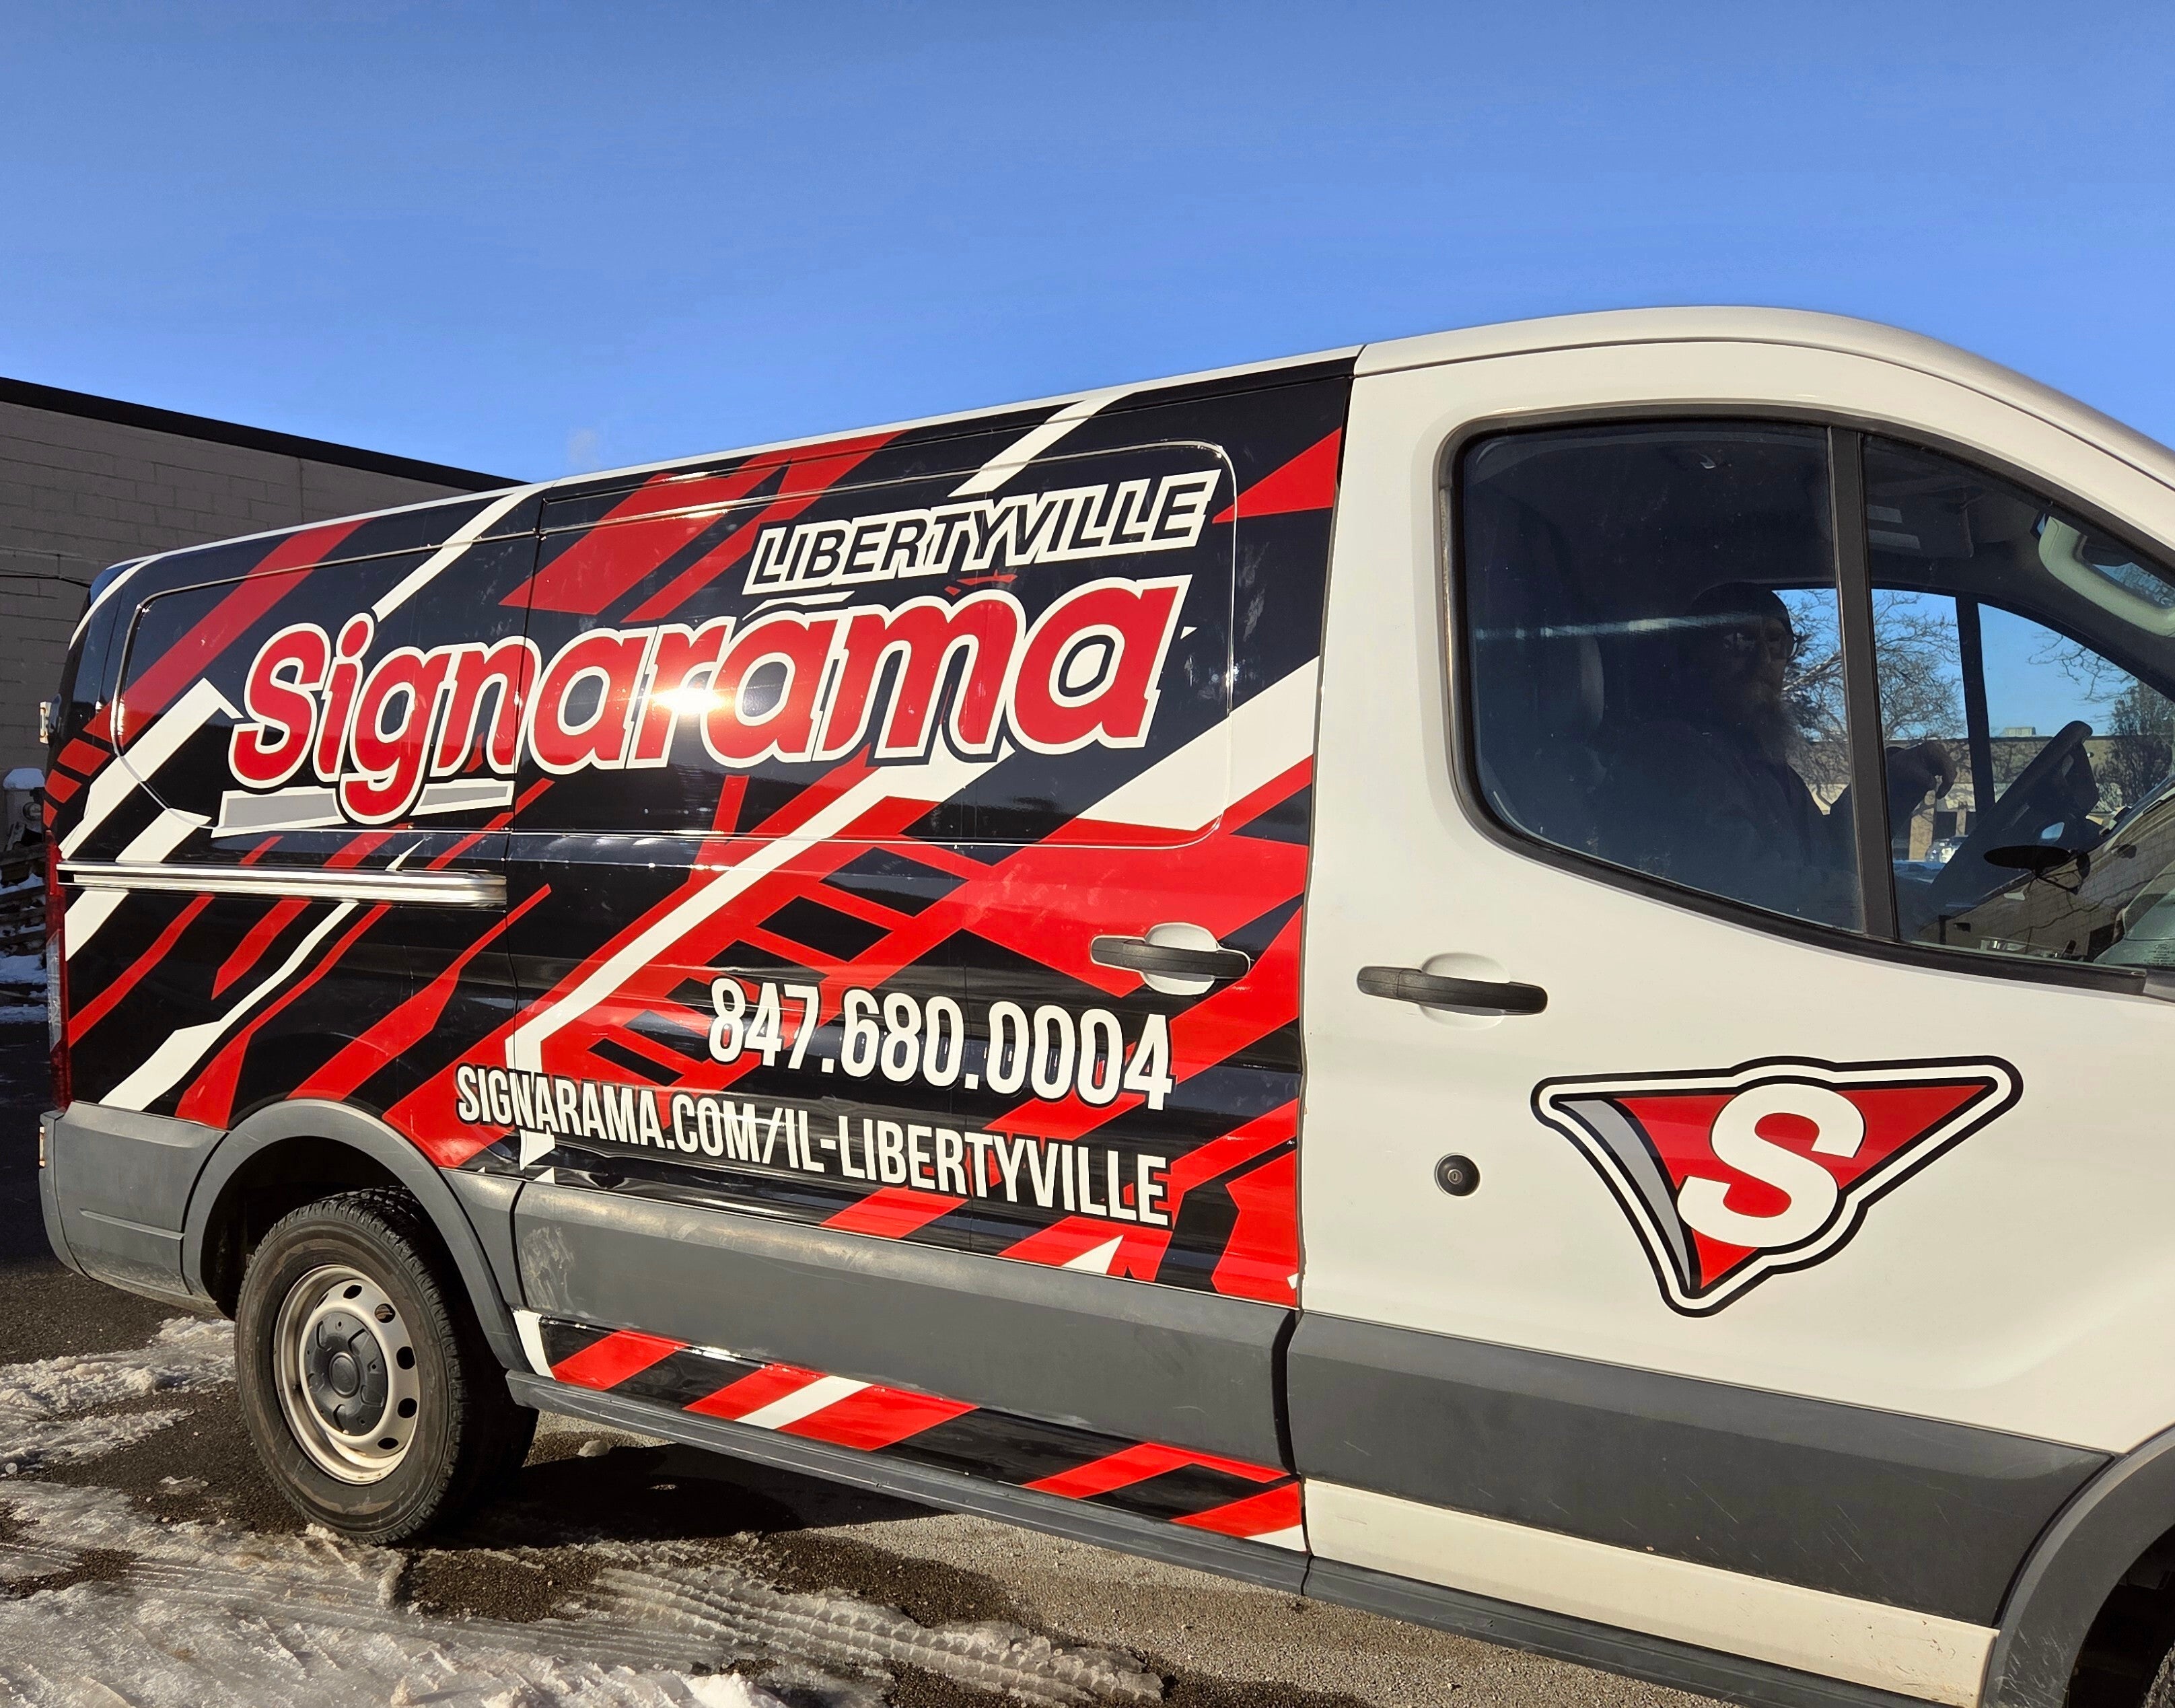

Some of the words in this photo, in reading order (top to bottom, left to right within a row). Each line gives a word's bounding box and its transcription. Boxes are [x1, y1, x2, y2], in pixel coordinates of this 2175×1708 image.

[746, 471, 1218, 592] LIBERTYVILLE
[228, 575, 1192, 824] Signarama
[709, 978, 1173, 1110] 847.680.0004
[458, 1065, 1170, 1225] SIGNARAMA.COM/IL-LIBERTYVILLE
[1677, 1083, 1864, 1247] S
